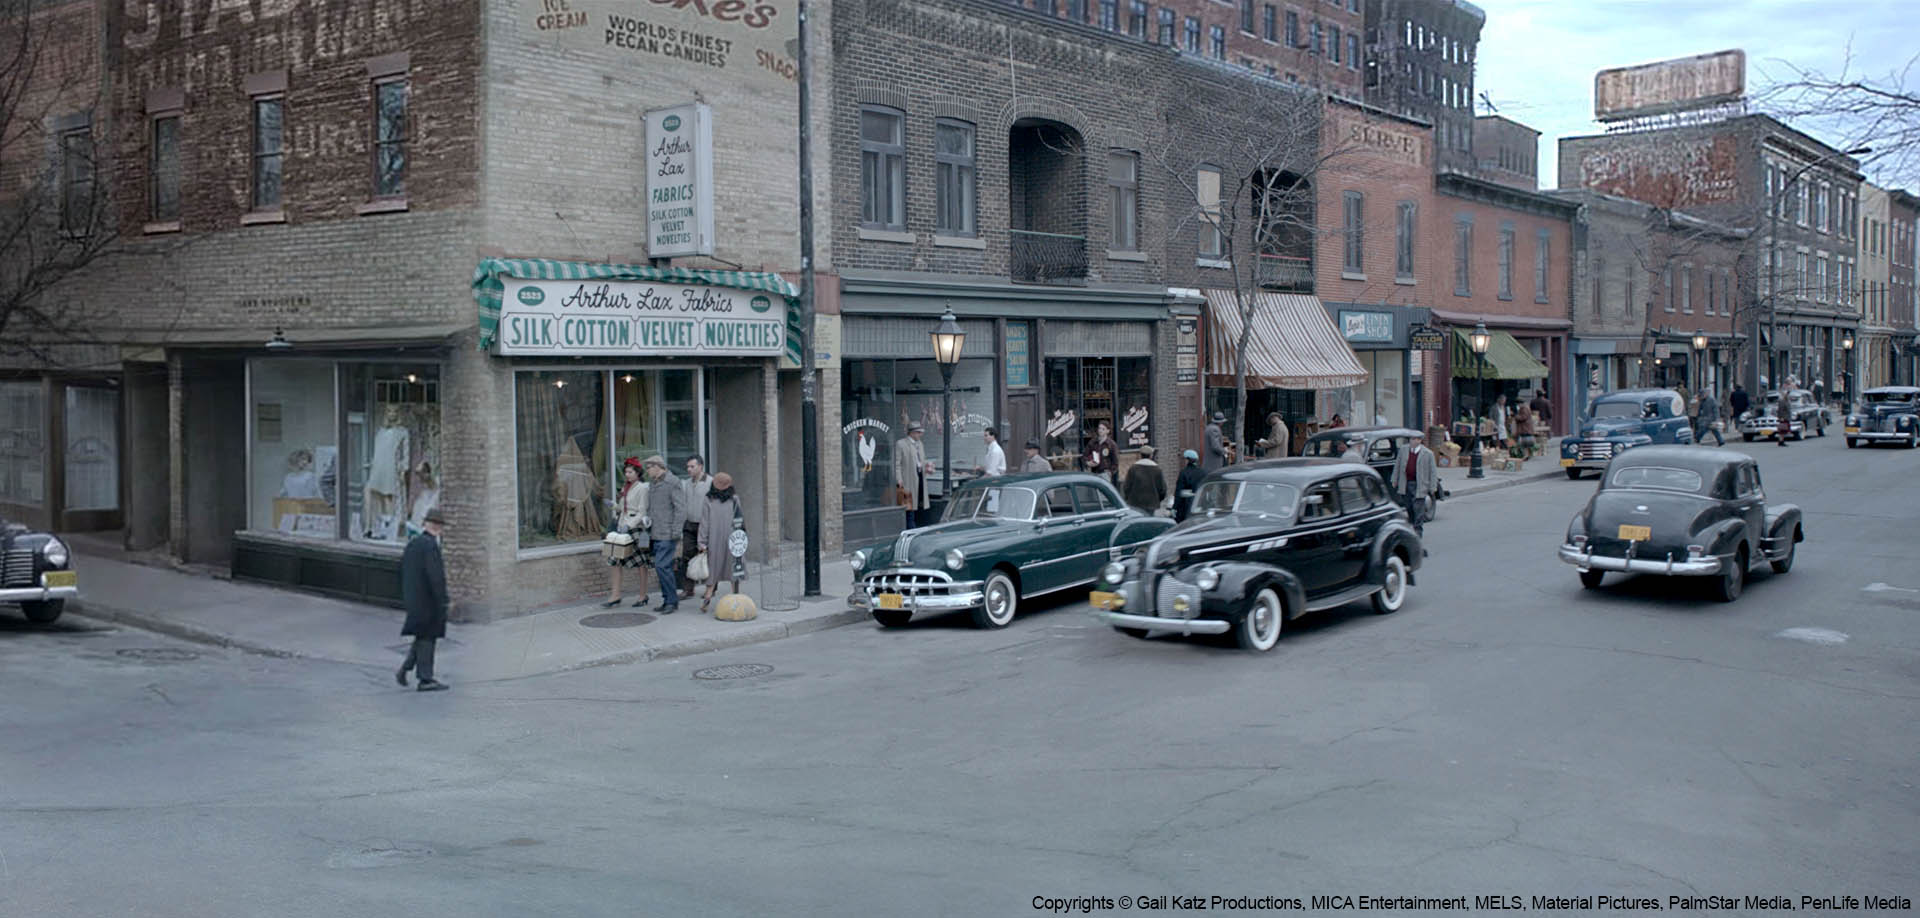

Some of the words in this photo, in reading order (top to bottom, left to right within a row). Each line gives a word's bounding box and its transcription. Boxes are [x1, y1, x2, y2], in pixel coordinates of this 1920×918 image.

[537, 12, 588, 30] CREAM
[608, 14, 677, 41] WORLDS
[681, 31, 733, 54] FINEST
[605, 29, 659, 54] PECAN
[663, 44, 727, 68] CANDIES
[653, 136, 692, 157] Arthur
[658, 156, 685, 176] Lax
[653, 184, 694, 204] FABRICS
[651, 210, 667, 221] SILK
[668, 207, 694, 220] COTTON
[661, 221, 685, 232] VELVET
[656, 232, 692, 246] NOVELTIES
[561, 283, 631, 308] Arthur
[637, 287, 674, 311] Lax
[679, 288, 733, 313] Fabrics
[511, 317, 553, 345] SILK
[564, 319, 630, 346] COTTON
[640, 320, 695, 347] VELVET
[705, 322, 780, 347] NOVELTIES
[1412, 336, 1443, 344] TAILOR
[843, 418, 867, 434] CHICKEN
[868, 418, 890, 433] MARKET
